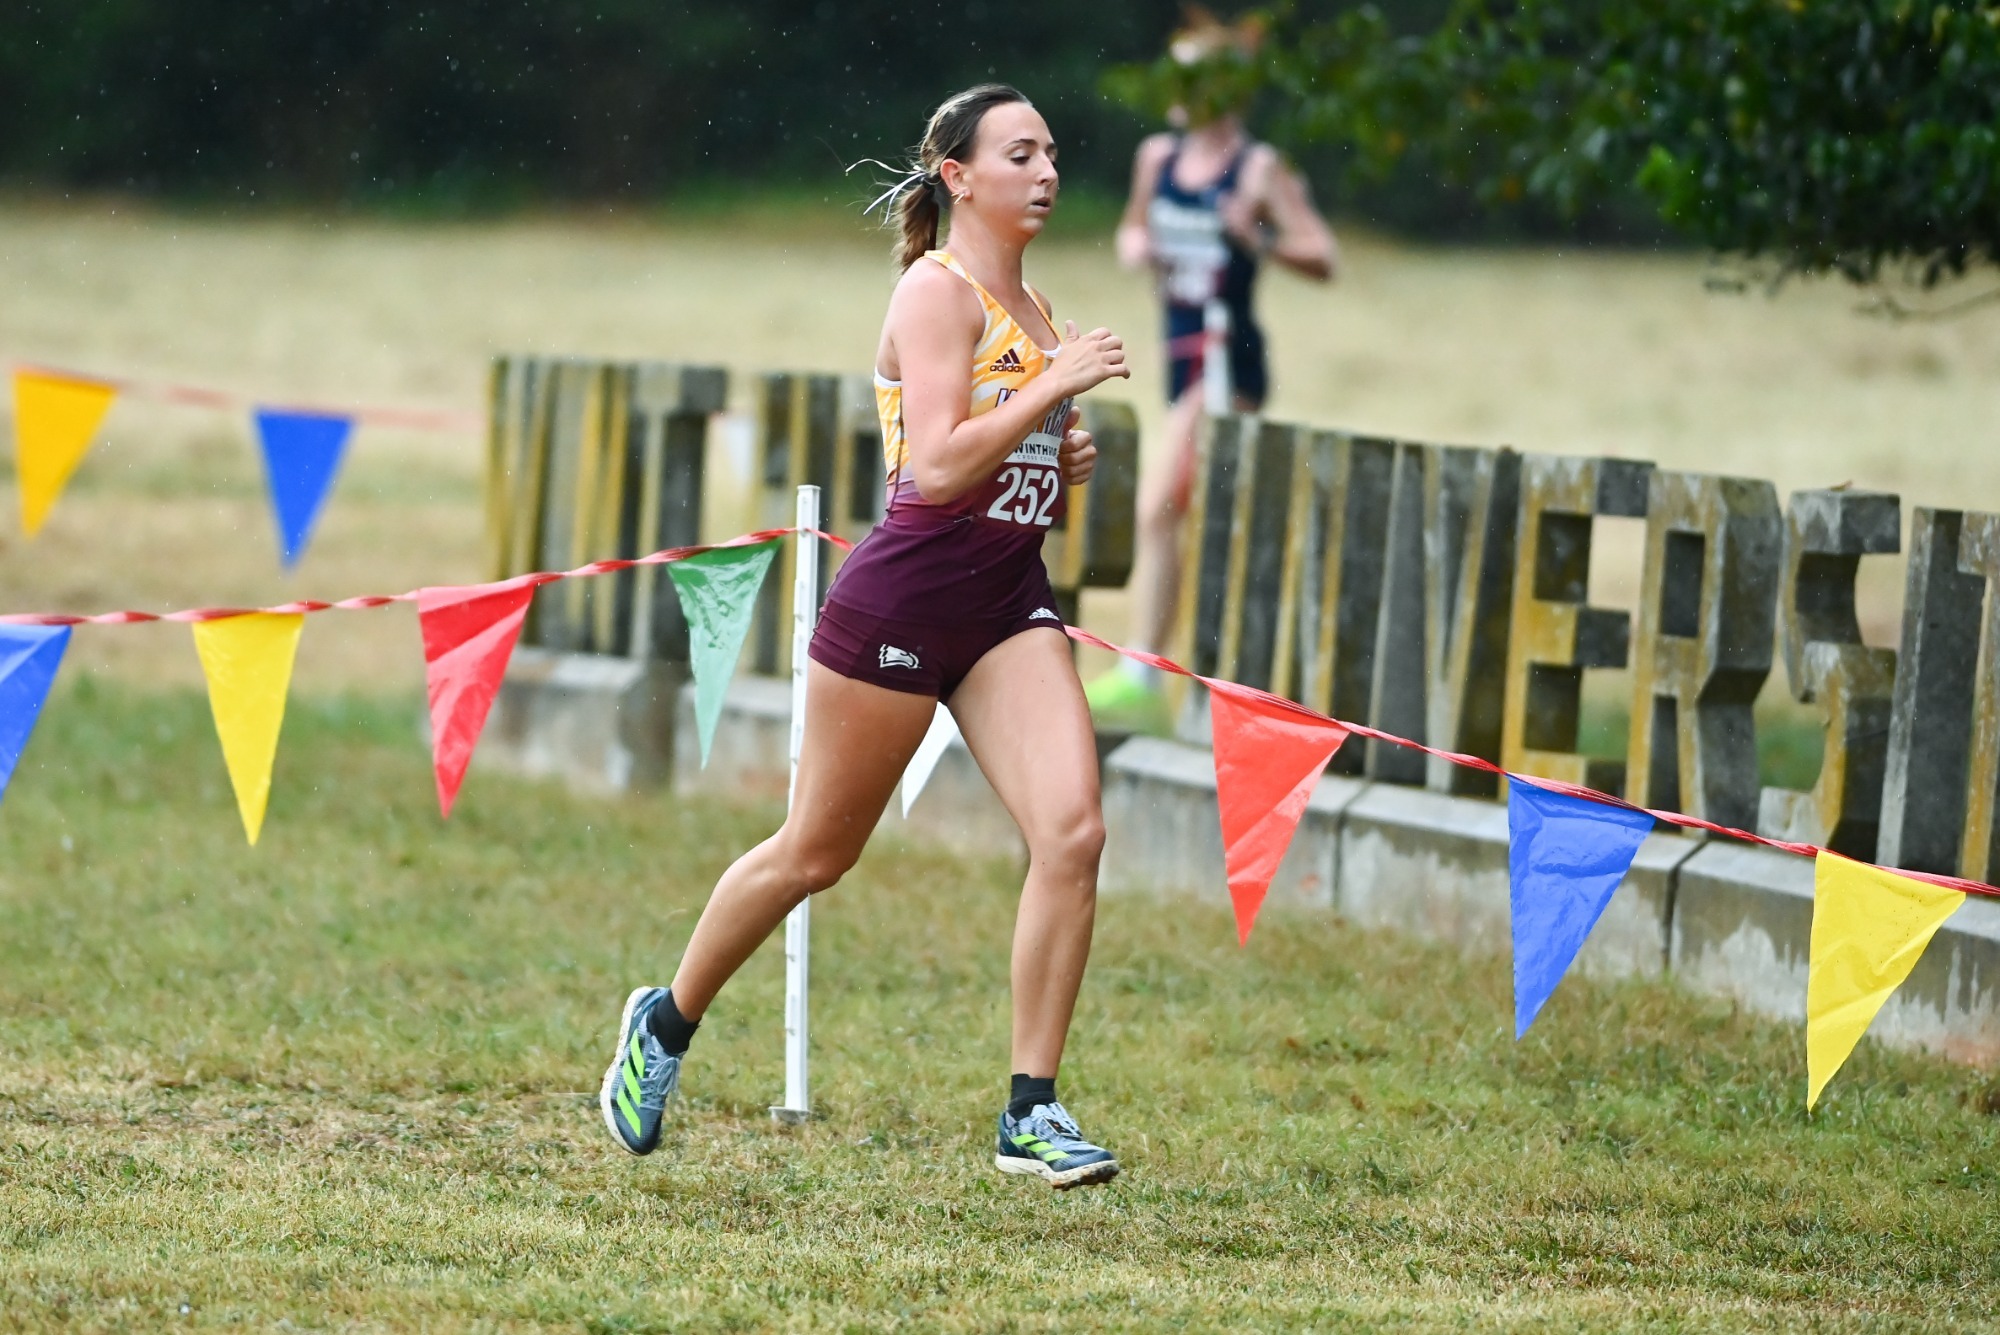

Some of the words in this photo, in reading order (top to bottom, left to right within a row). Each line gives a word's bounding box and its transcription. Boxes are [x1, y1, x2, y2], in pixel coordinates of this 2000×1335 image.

[990, 363, 1026, 373] adidas
[1015, 443, 1058, 457] WINTH
[987, 466, 1059, 526] 252
